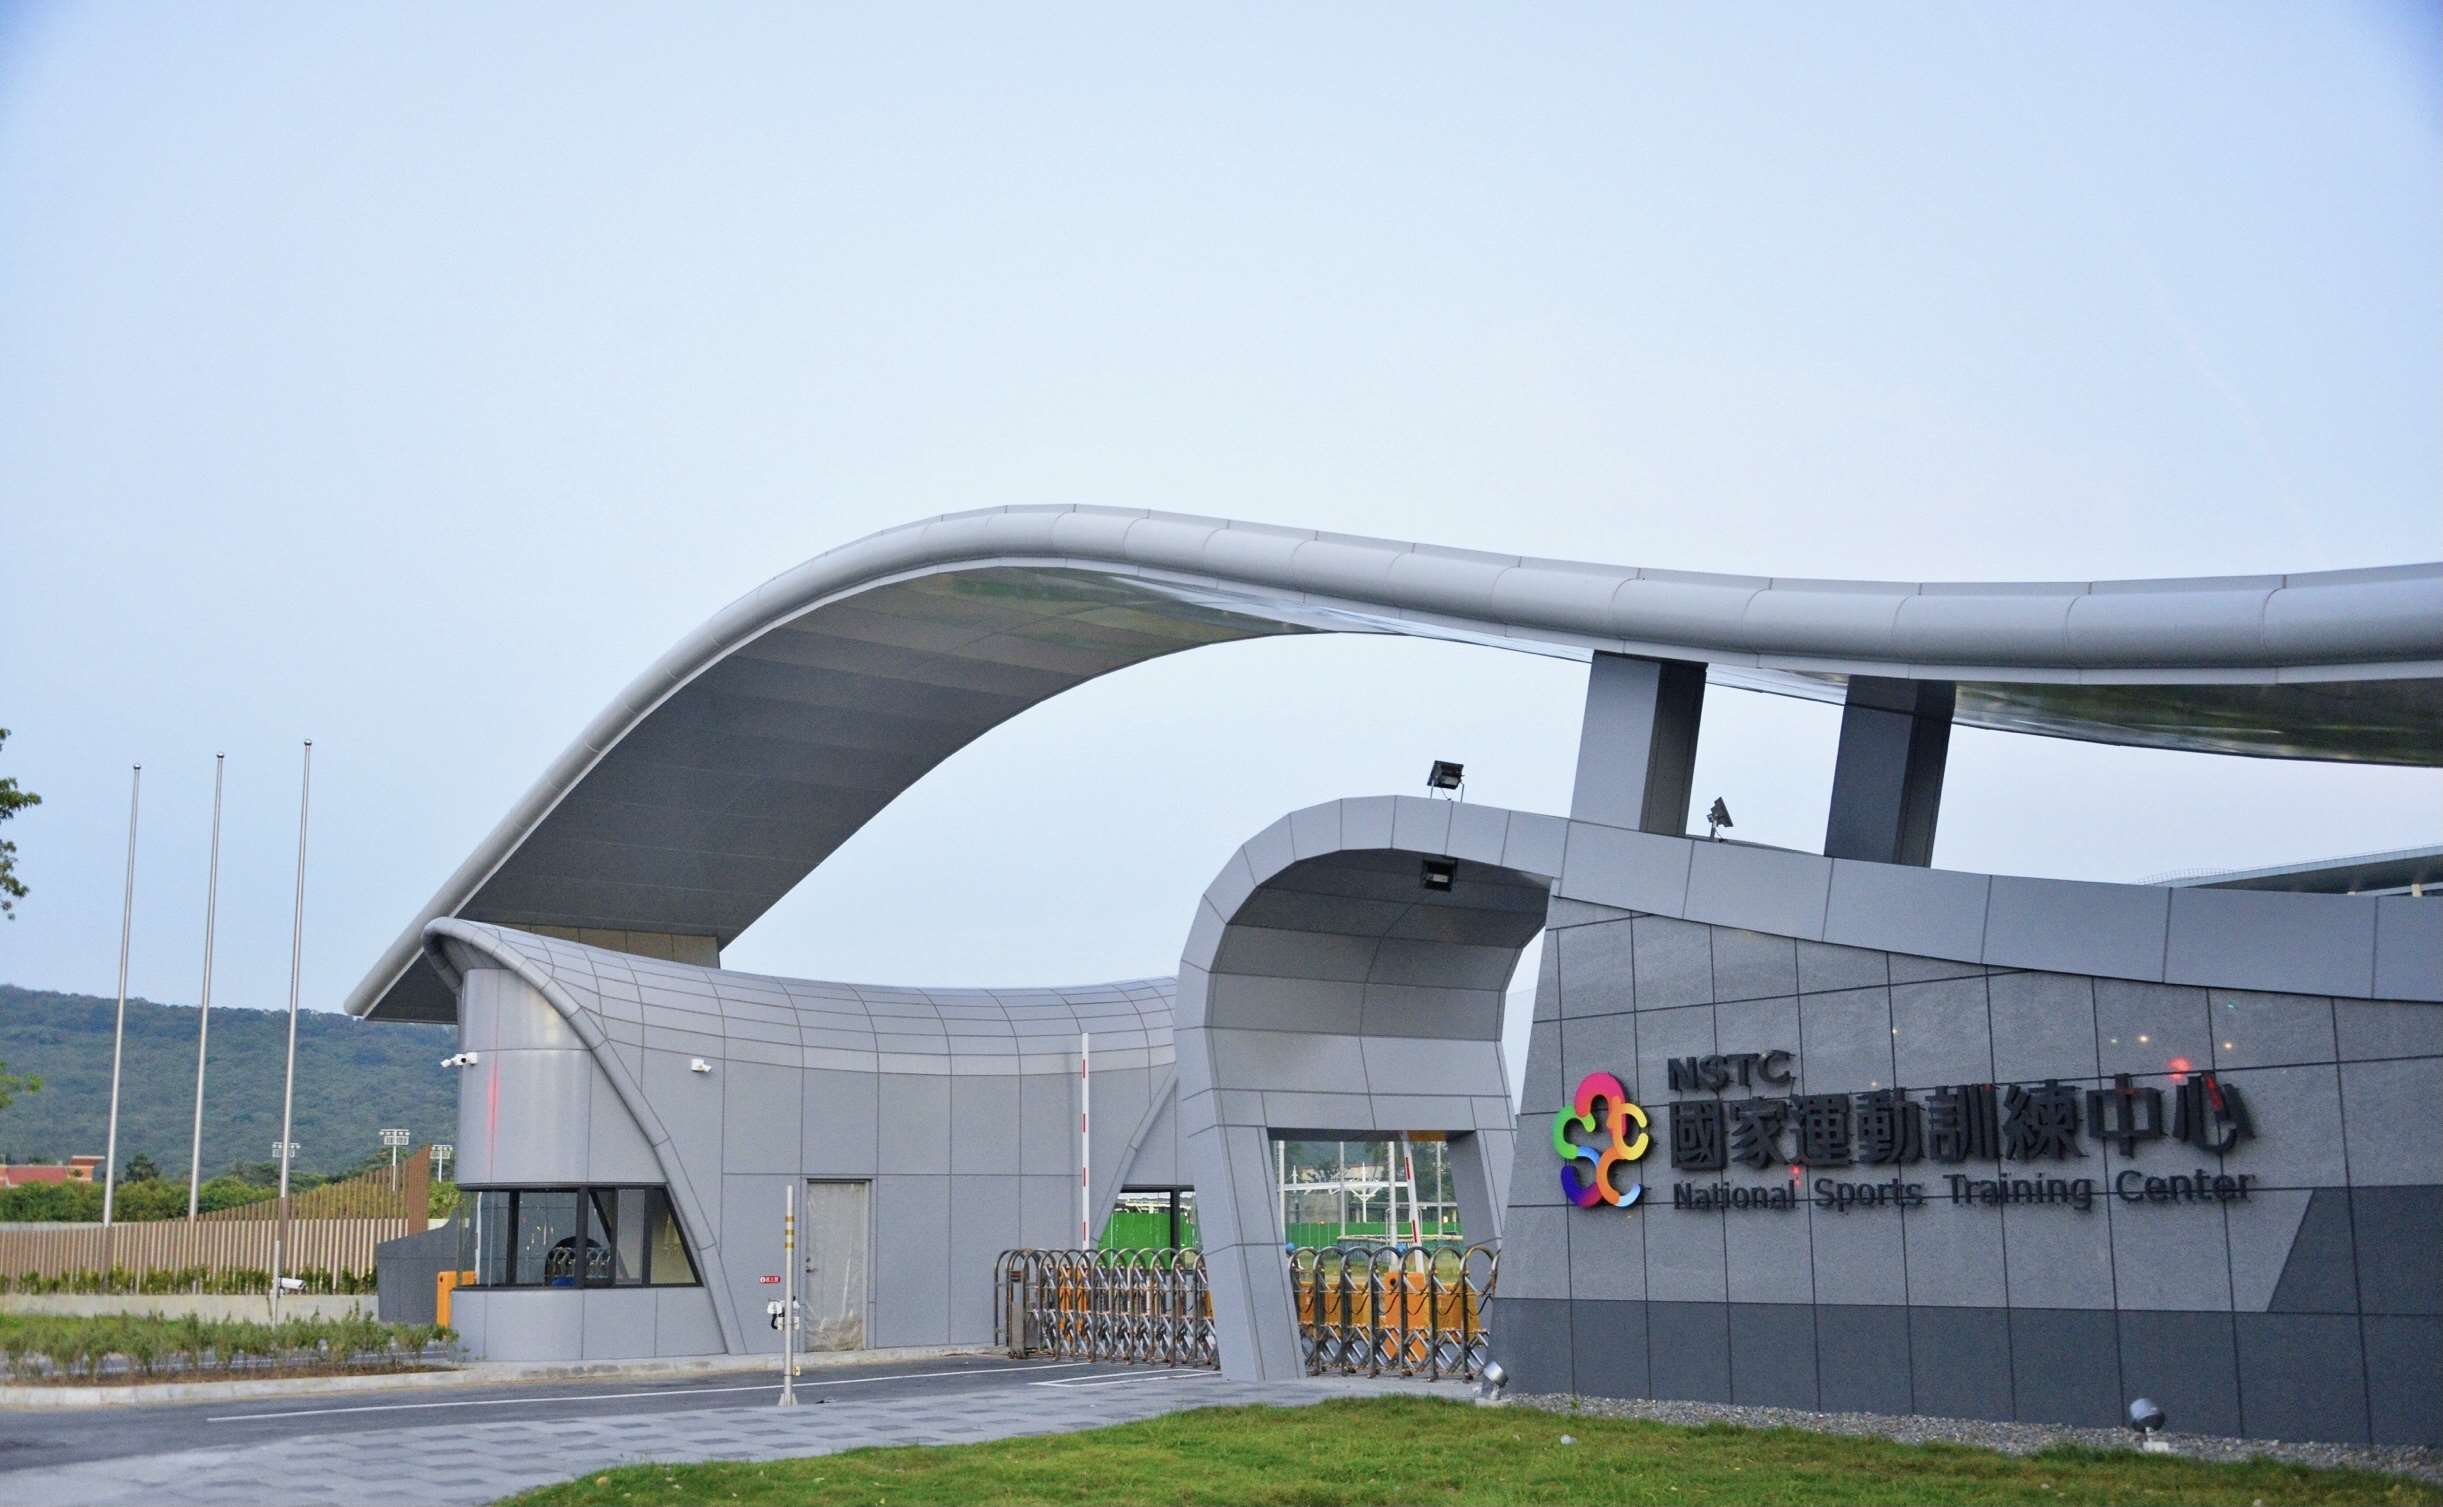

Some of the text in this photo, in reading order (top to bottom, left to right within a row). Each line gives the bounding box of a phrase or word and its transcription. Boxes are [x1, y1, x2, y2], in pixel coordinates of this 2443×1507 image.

[1669, 1051, 1793, 1090] NSTC
[1670, 1073, 2255, 1169] 國家運動訓練中心
[1674, 1170, 2255, 1210] National Sports Training Center
